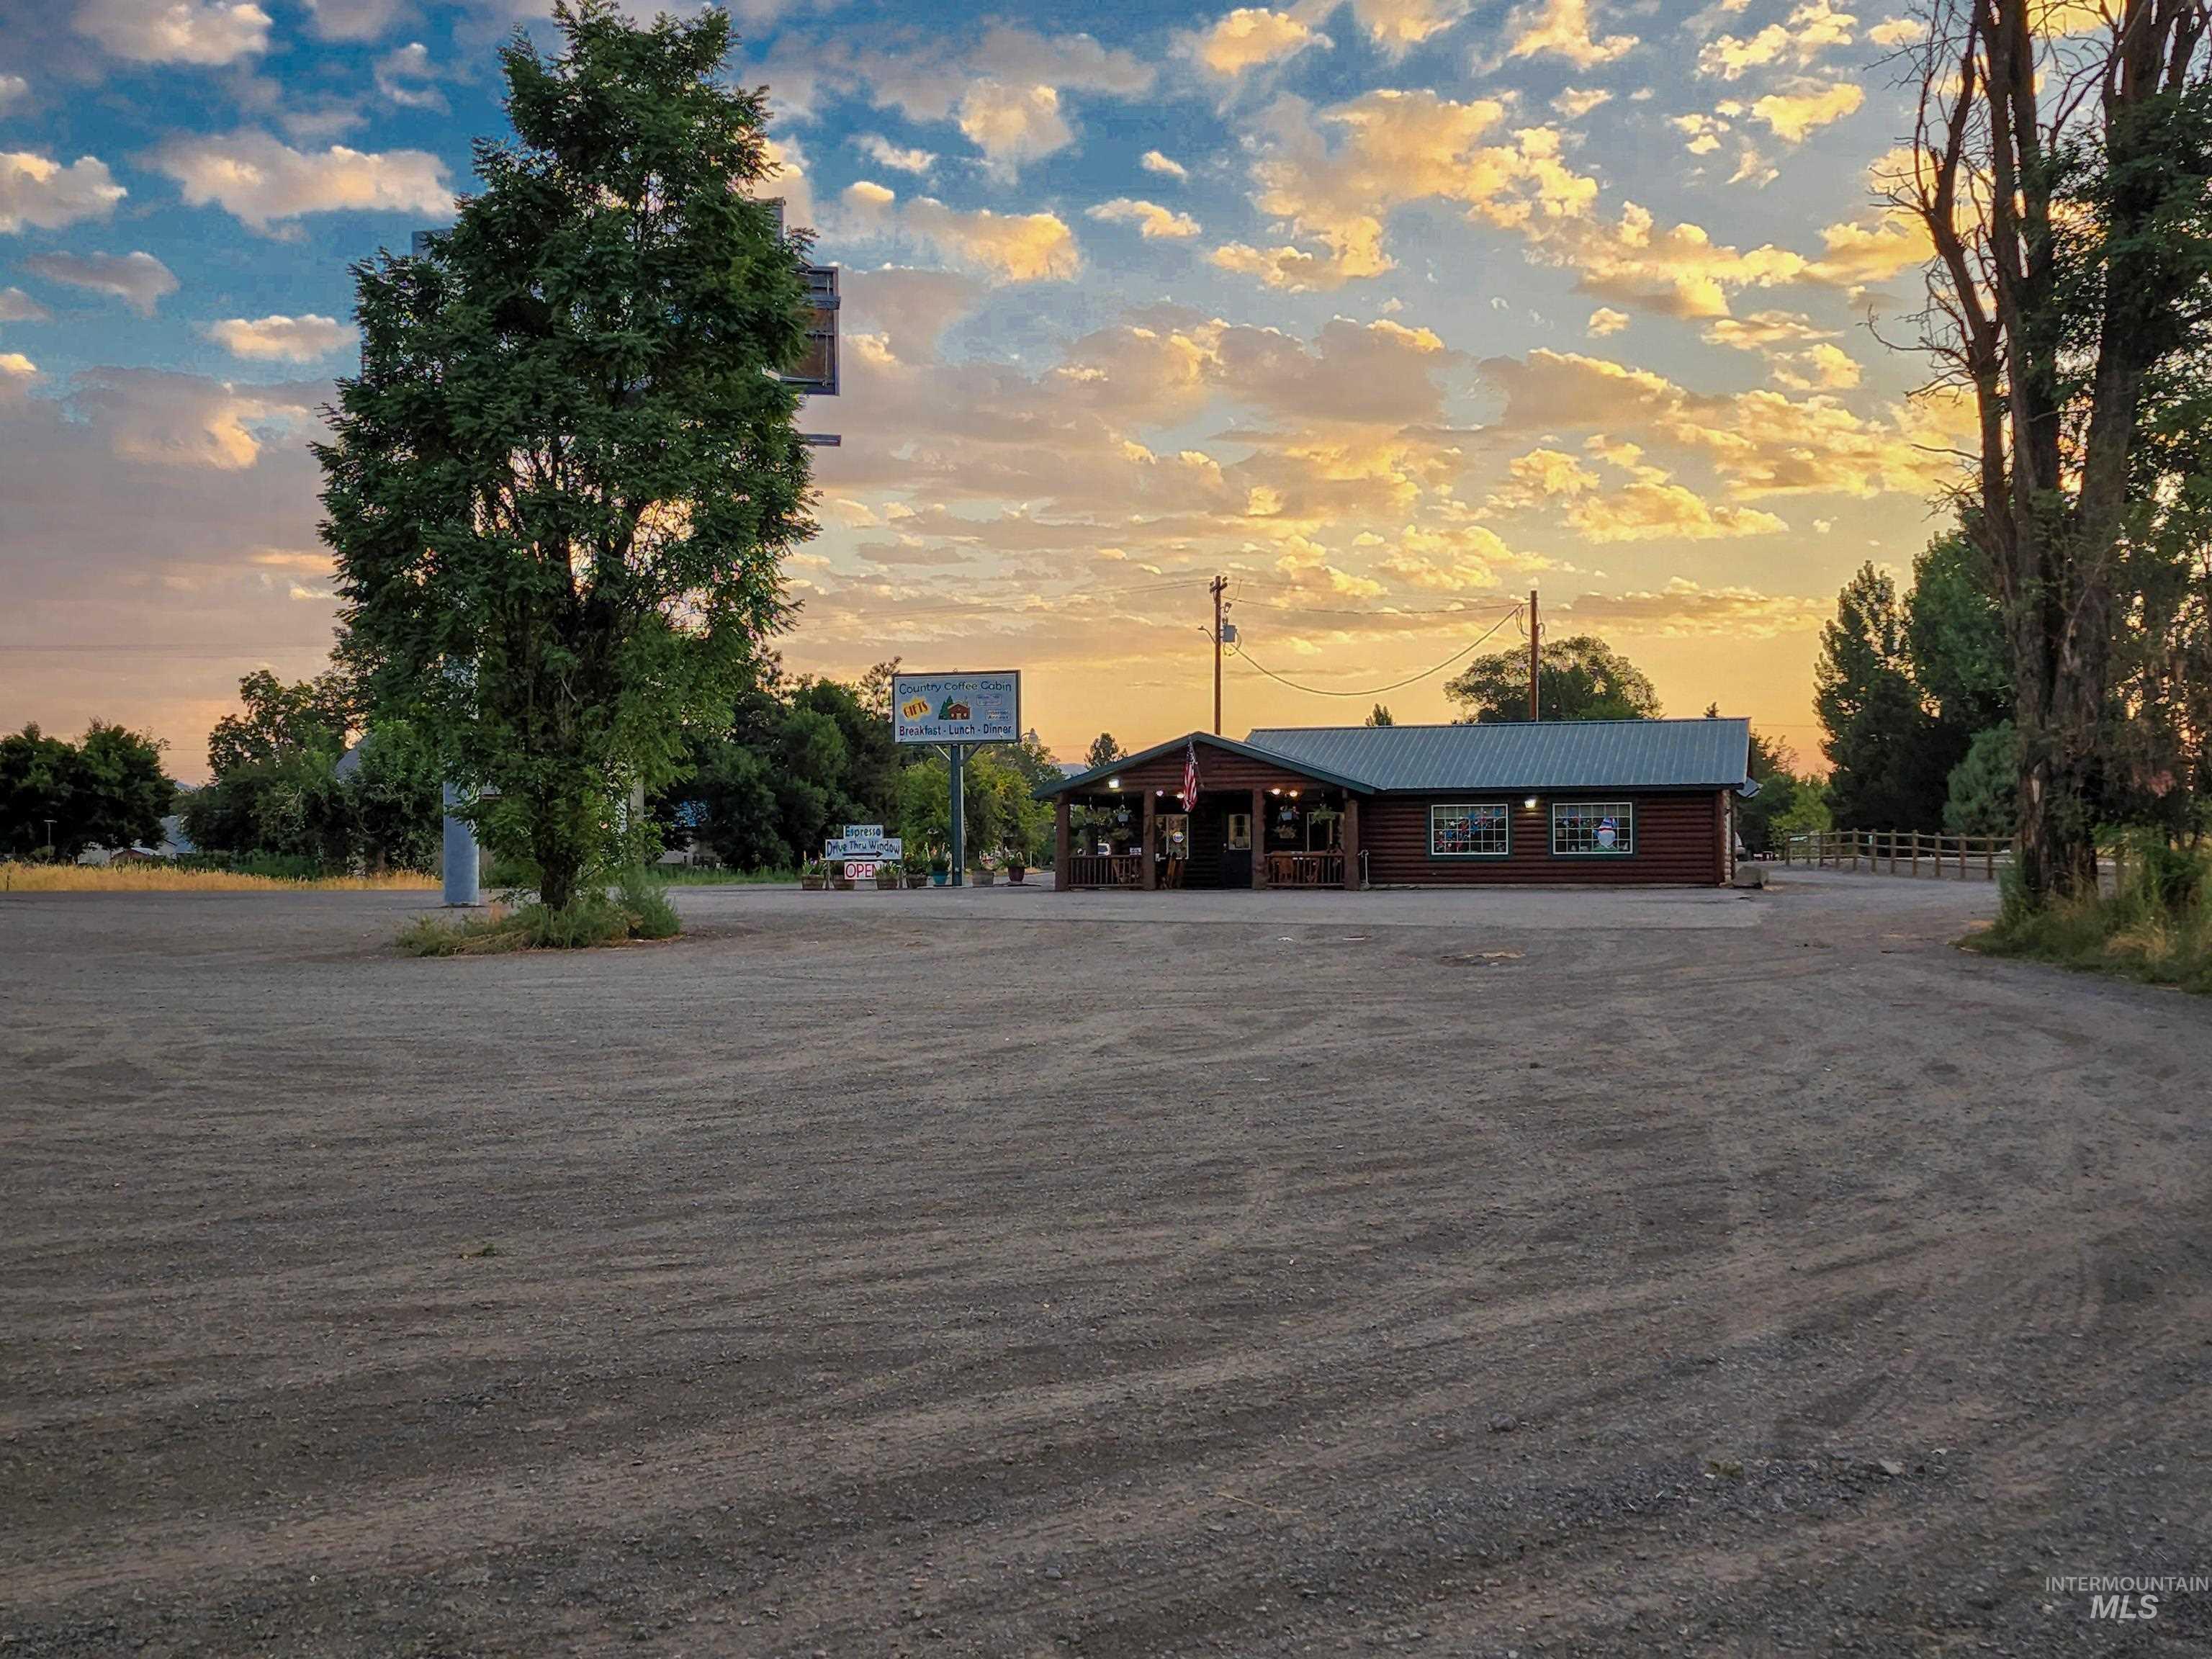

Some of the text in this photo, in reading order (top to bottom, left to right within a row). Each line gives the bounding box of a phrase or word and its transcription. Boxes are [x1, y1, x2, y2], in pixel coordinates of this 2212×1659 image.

[899, 683, 940, 694] Country
[980, 680, 1012, 692] Cabin
[903, 701, 929, 718] GIFTS
[899, 724, 1012, 736] Breakfast Lunch Dinner
[845, 826, 881, 837] Espresso
[827, 840, 900, 857] Drive Thru Window
